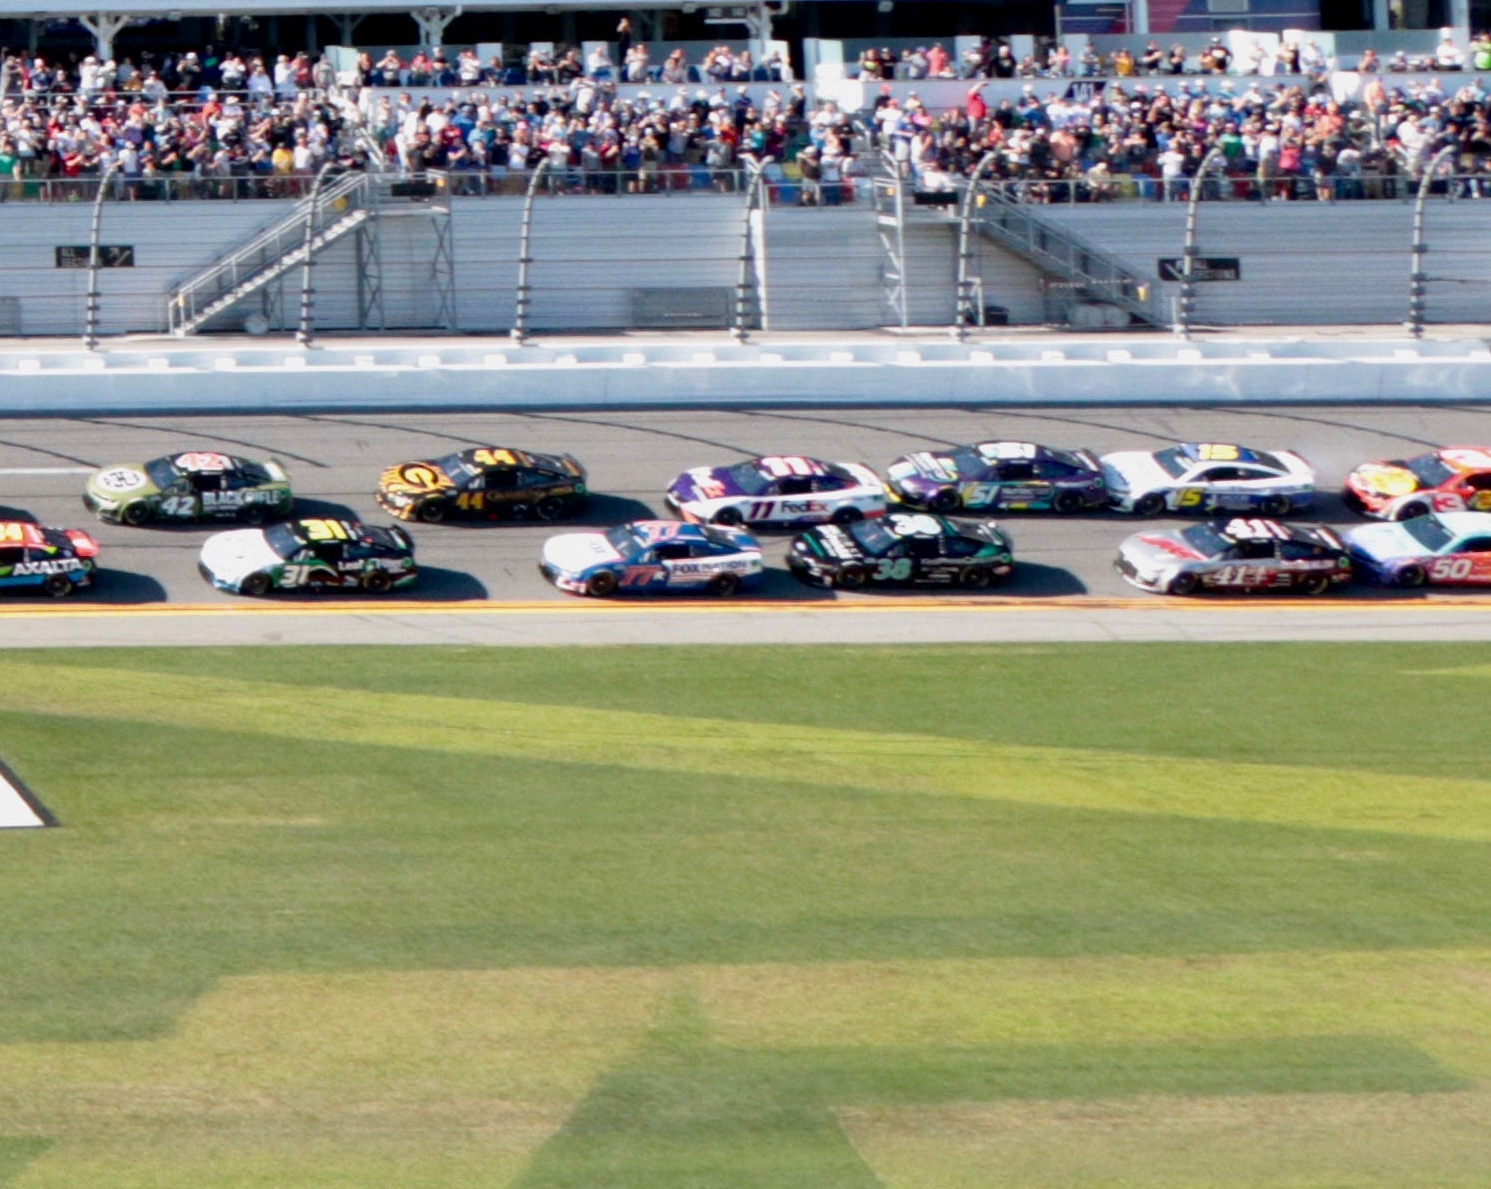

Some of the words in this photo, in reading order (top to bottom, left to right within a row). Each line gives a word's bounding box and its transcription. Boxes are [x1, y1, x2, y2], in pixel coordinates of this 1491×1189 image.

[201, 491, 243, 506] BLACK
[456, 493, 484, 510] 44
[970, 485, 1000, 504] 51
[1180, 489, 1203, 506] 15
[161, 496, 195, 515] 42
[748, 501, 776, 520] 11
[780, 500, 829, 515] FedEx
[299, 519, 348, 540] 31
[12, 558, 83, 576] AXALTA
[672, 562, 699, 574] FOX
[701, 558, 747, 572] NATION
[872, 558, 913, 580] 38
[1213, 565, 1243, 585] 41
[1430, 558, 1473, 579] 50
[279, 564, 312, 588] 31
[619, 566, 664, 587] 77
